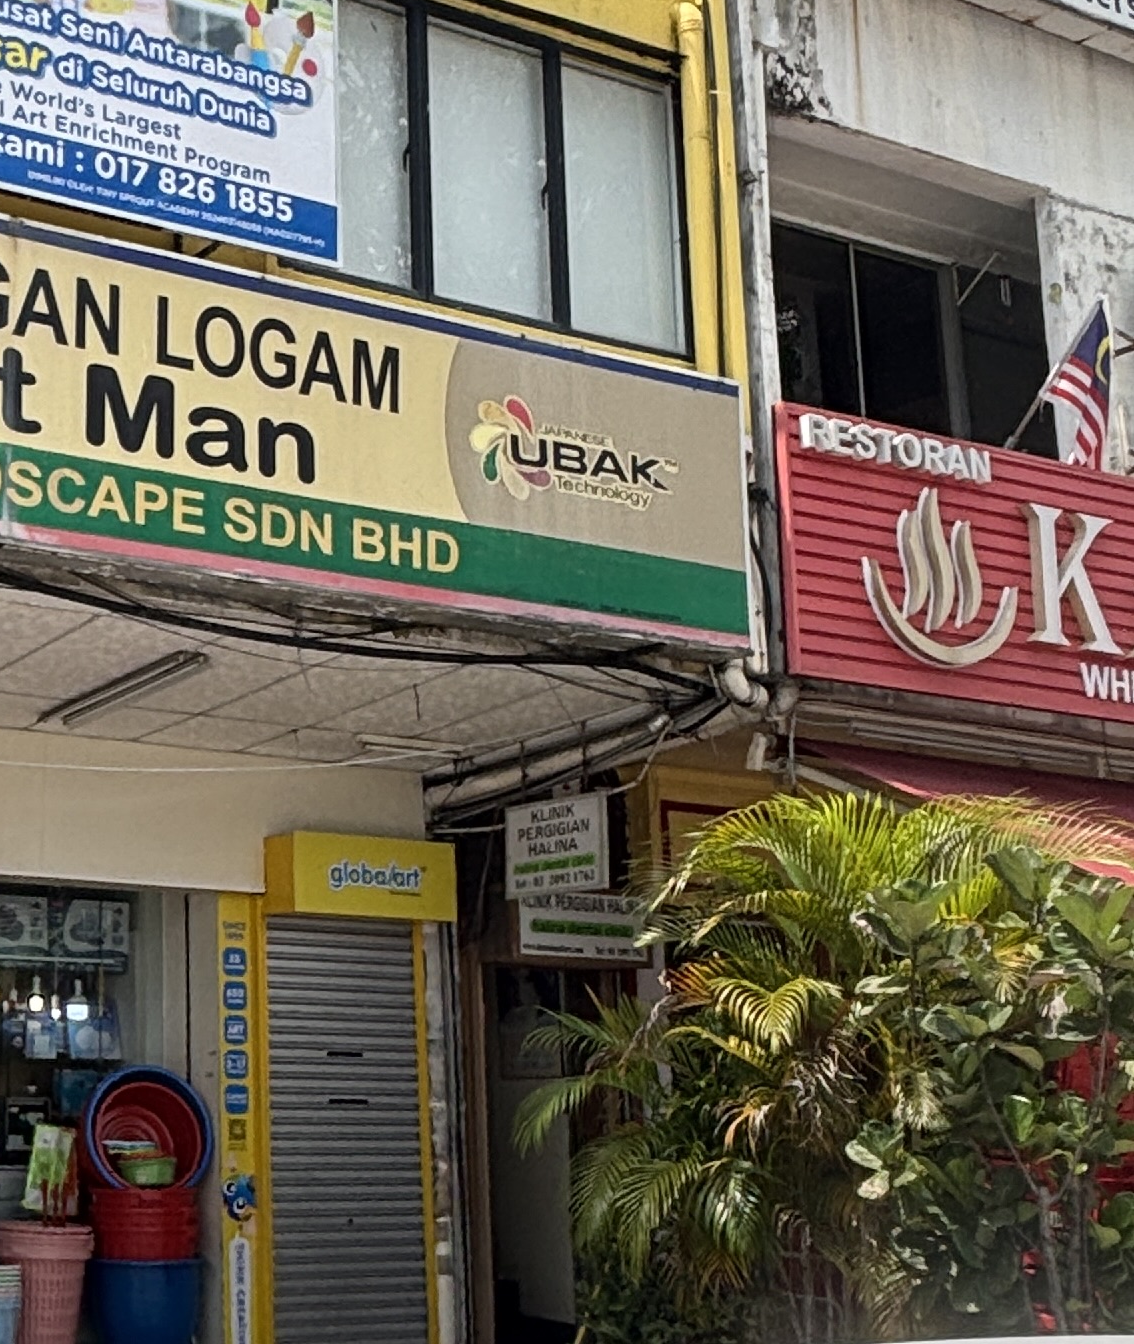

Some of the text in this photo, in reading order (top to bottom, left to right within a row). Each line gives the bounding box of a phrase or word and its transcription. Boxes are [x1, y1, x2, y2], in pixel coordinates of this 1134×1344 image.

[54, 54, 85, 84] di
[91, 66, 193, 116] Seluruh
[198, 93, 273, 134] Dunia
[59, 12, 124, 49] Seni
[128, 31, 310, 106] Antarabangsa
[12, 97, 48, 128] Art
[54, 113, 179, 164] Enrichment
[183, 146, 273, 187] Program
[101, 100, 183, 142] Largest
[94, 150, 151, 189] 017
[157, 165, 216, 206] 826
[224, 181, 294, 224] 1855
[156, 293, 400, 415] LOGAM
[84, 361, 316, 485] Man
[798, 413, 992, 484] RESTORAN
[510, 433, 669, 492] UBAK
[554, 474, 651, 509] Technology
[223, 496, 334, 556] SDN
[351, 517, 461, 575] BHD
[518, 818, 590, 843] PERGIGIAN
[528, 837, 578, 858] HALINA
[530, 803, 575, 824] KLINIK
